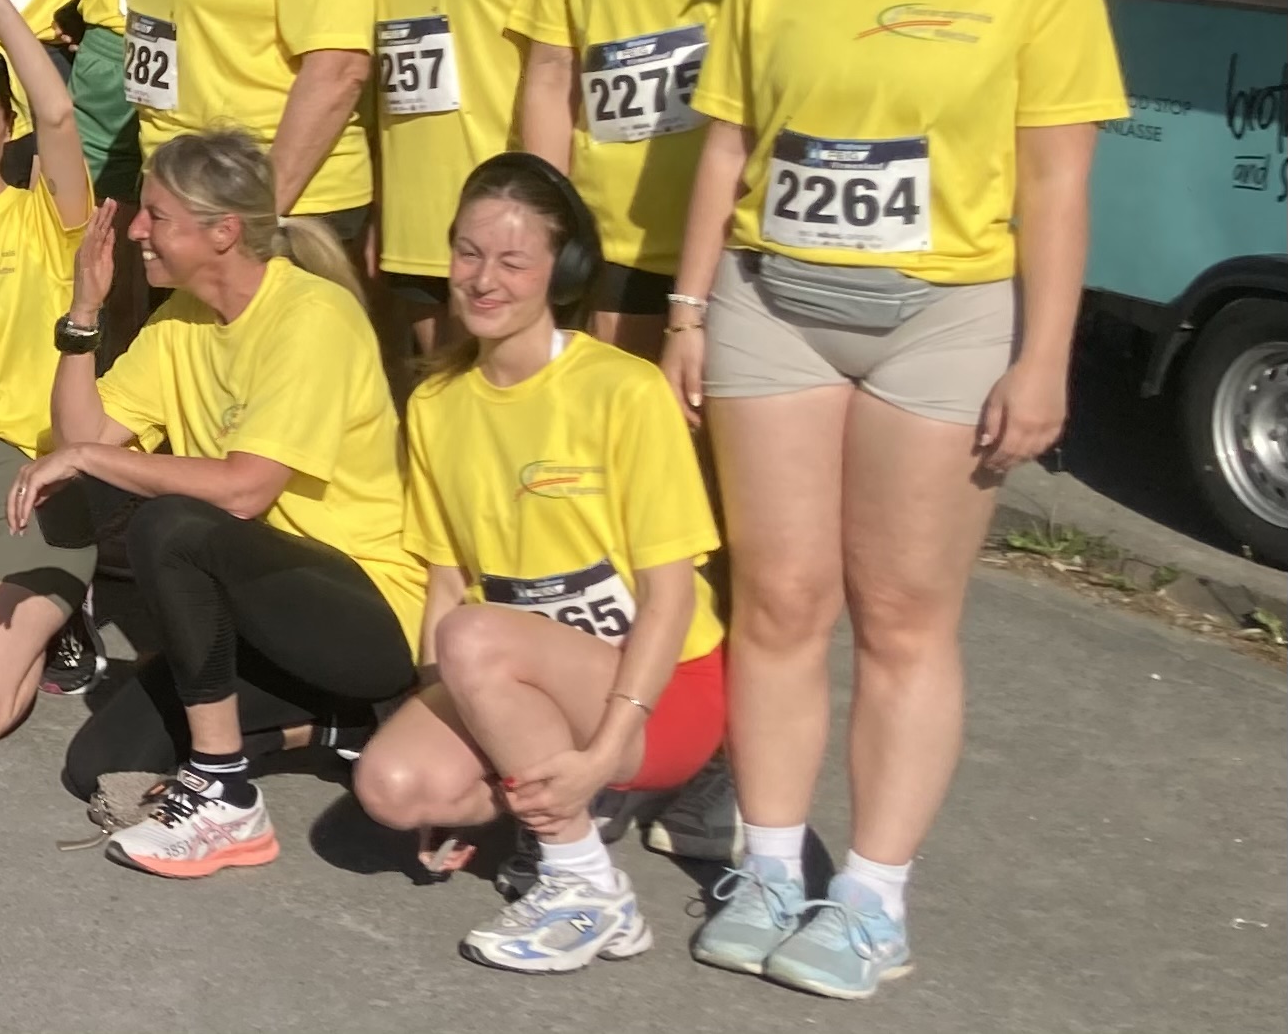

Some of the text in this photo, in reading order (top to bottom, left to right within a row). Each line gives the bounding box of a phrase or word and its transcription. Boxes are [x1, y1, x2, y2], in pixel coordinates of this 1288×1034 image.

[124, 44, 170, 90] 282
[380, 48, 444, 93] 257
[590, 61, 701, 122] 2275
[774, 169, 920, 227] 2264
[557, 595, 631, 637] 65
